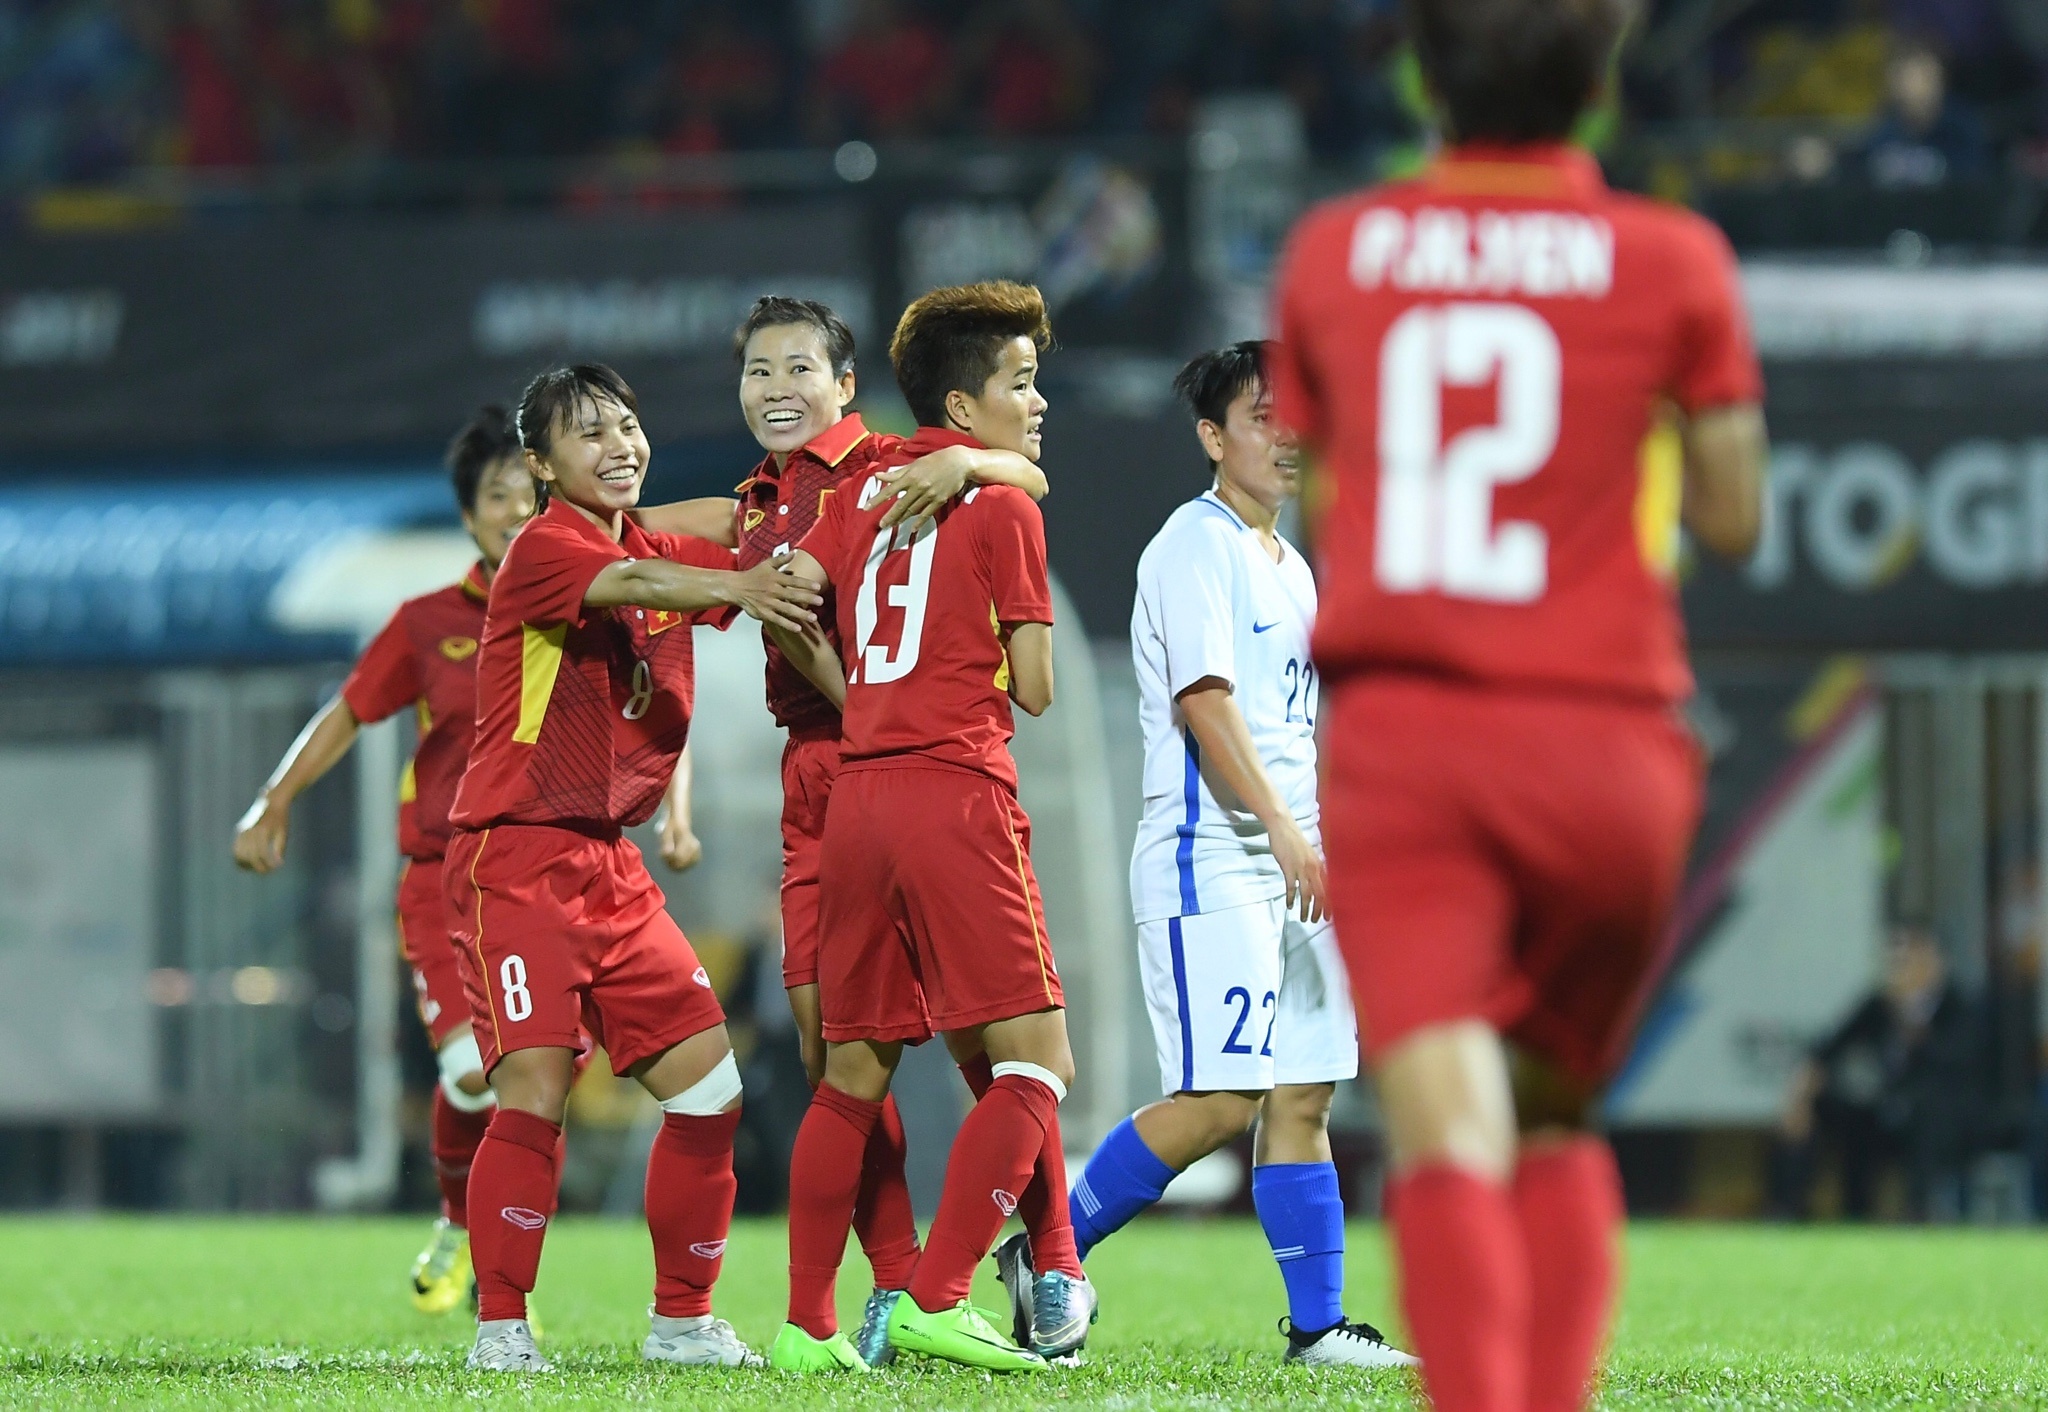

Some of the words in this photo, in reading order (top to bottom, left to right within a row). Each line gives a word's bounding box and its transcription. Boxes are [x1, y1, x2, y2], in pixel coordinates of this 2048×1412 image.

[1375, 302, 1563, 604] 12
[1751, 438, 2048, 591] TOG
[622, 660, 653, 719] 8
[1284, 658, 1313, 727] 22
[500, 954, 532, 1022] 8
[1221, 986, 1275, 1057] 22
